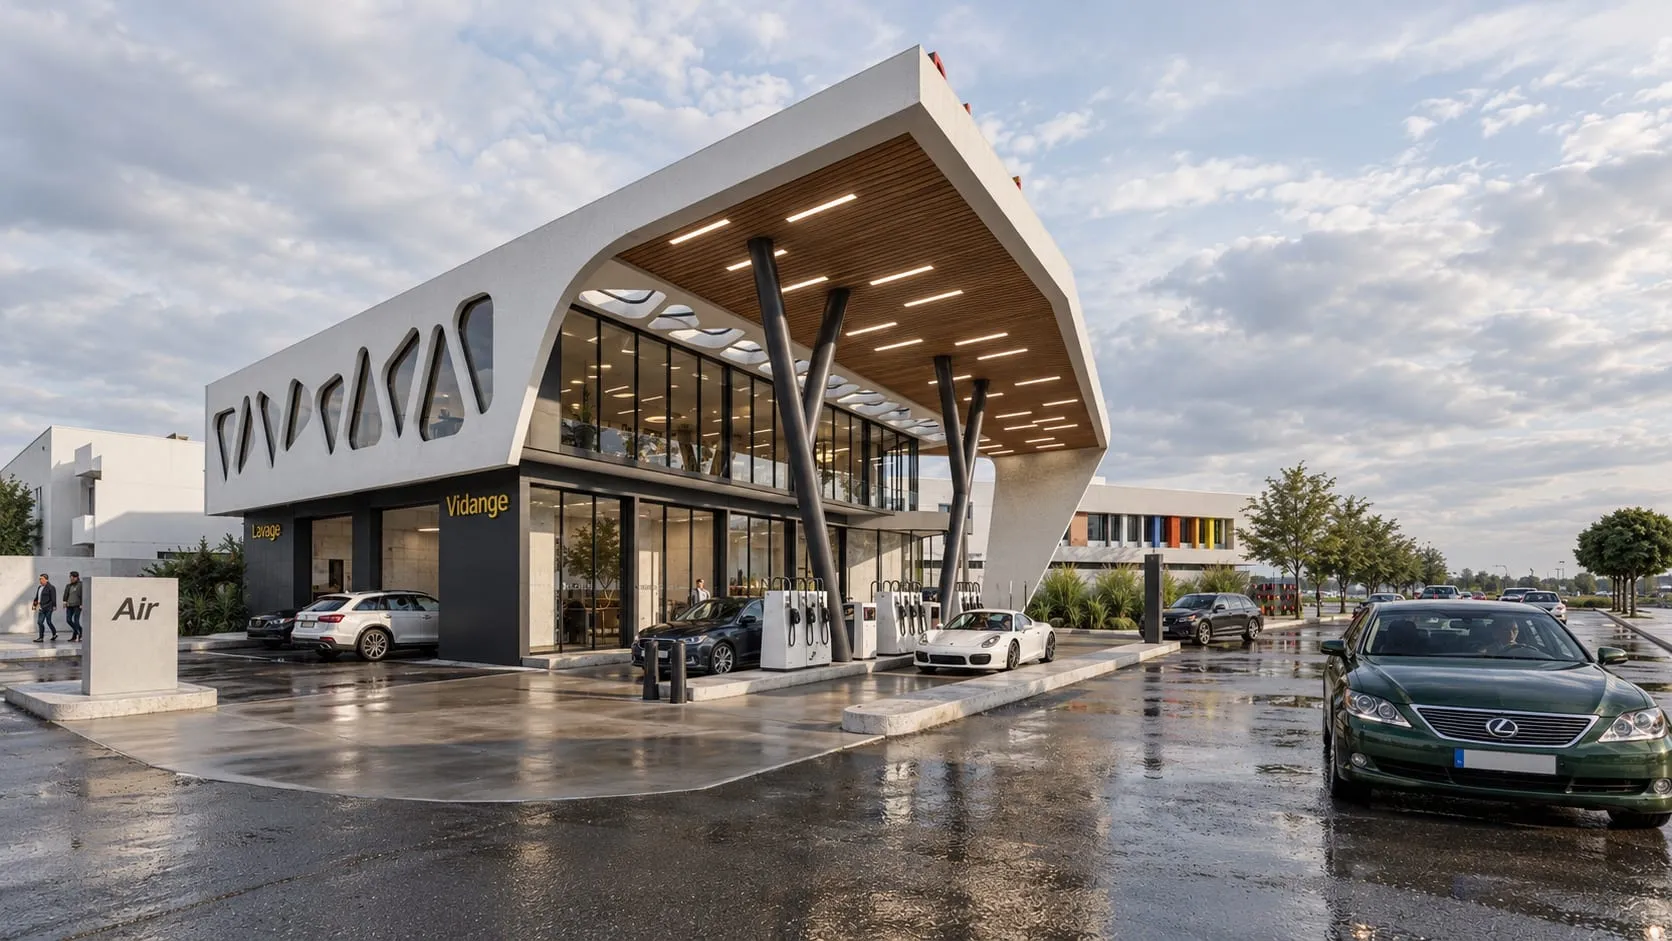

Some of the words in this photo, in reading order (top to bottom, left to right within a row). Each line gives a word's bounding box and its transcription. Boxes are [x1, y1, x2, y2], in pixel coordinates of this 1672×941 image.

[446, 493, 508, 518] Vidange
[252, 524, 281, 541] Lavage
[112, 597, 159, 620] Air
